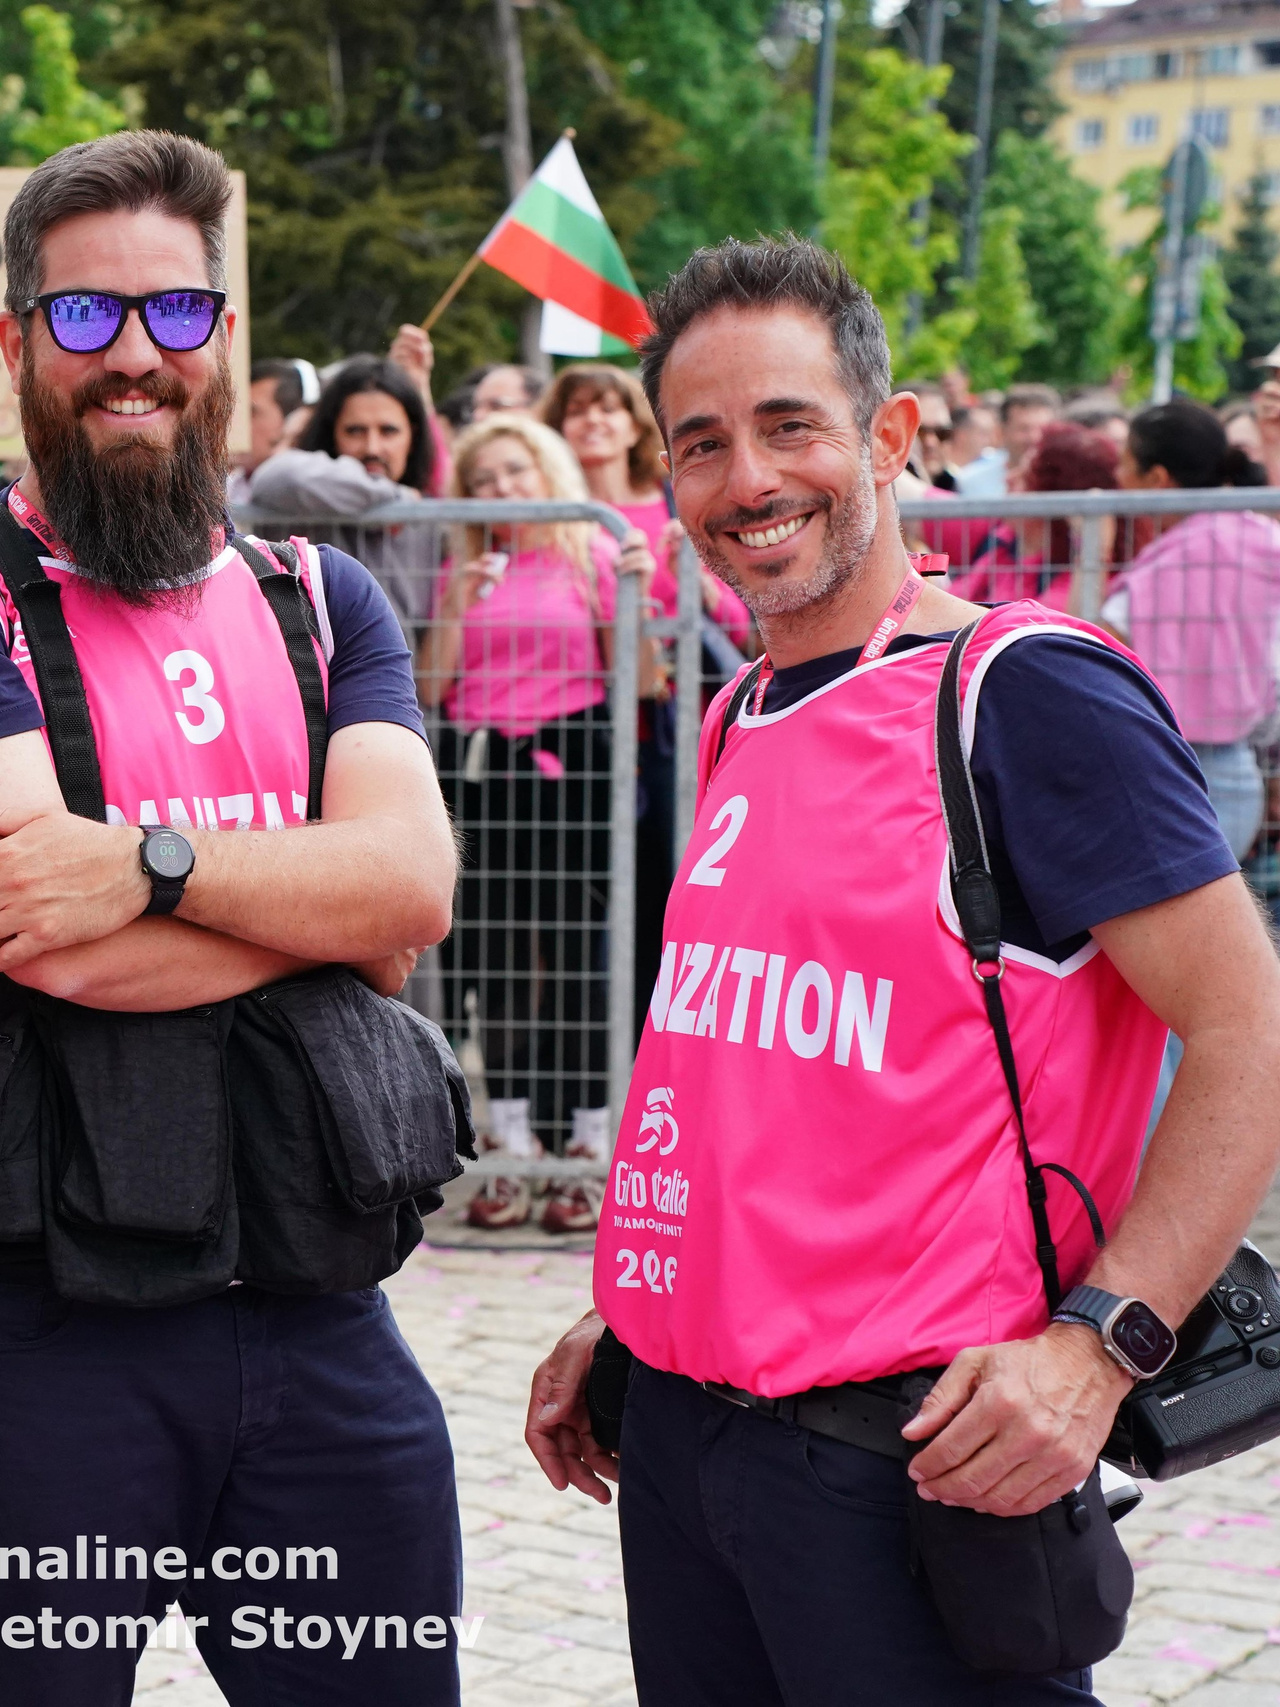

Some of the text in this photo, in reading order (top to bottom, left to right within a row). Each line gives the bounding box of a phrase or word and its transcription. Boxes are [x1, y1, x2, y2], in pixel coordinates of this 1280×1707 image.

[864, 617, 898, 659] Giro d'Italia
[163, 649, 225, 745] 3
[686, 794, 749, 887] 2
[1161, 1393, 1186, 1407] SONY
